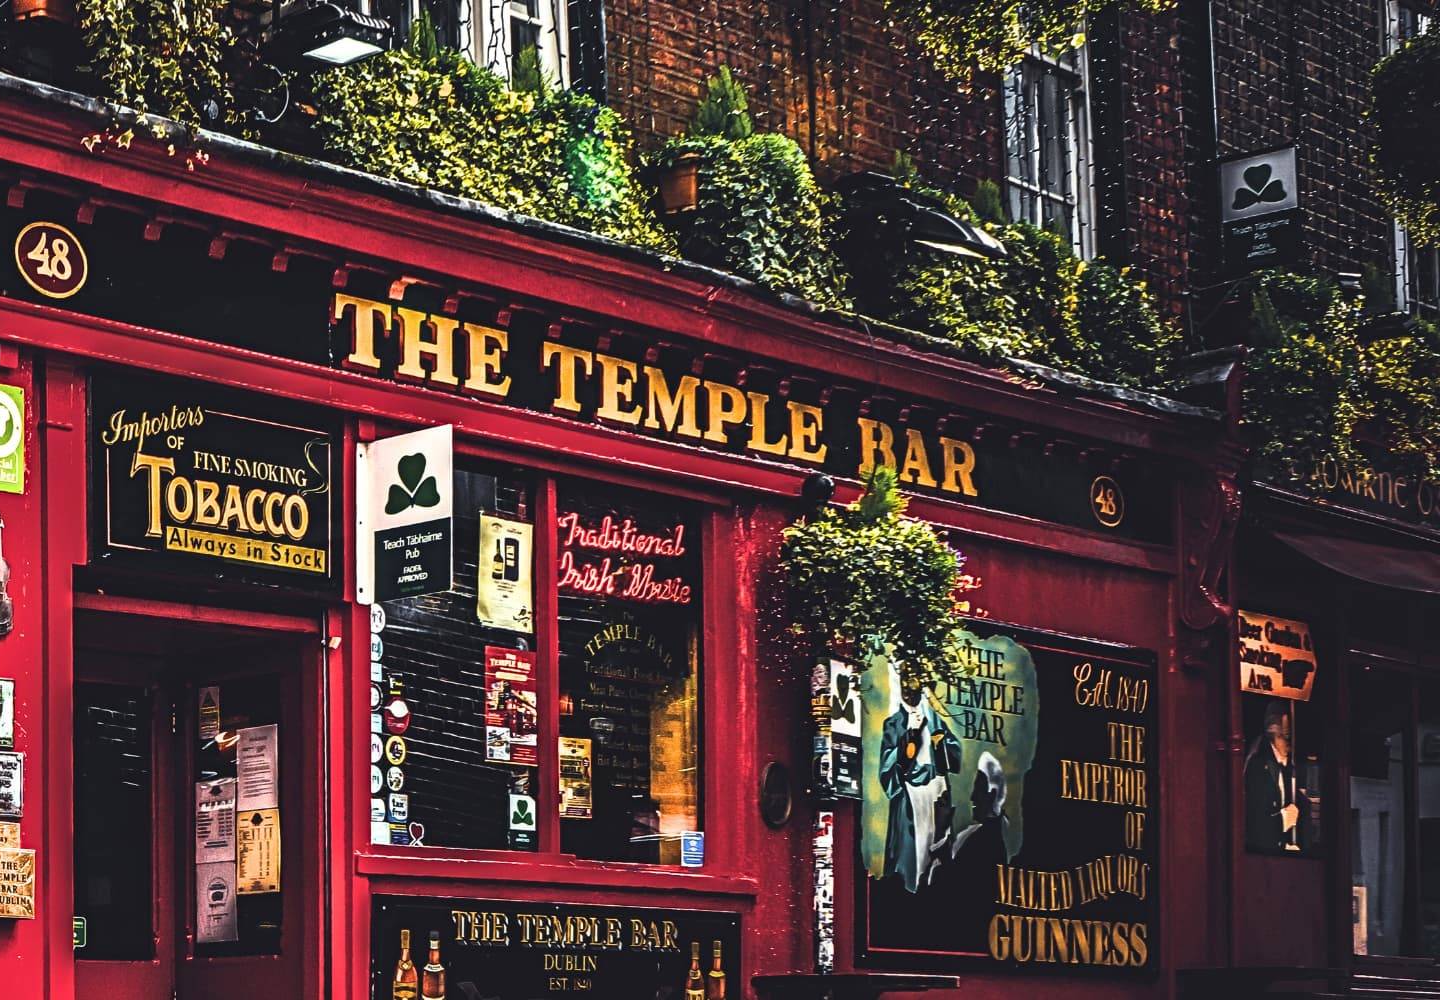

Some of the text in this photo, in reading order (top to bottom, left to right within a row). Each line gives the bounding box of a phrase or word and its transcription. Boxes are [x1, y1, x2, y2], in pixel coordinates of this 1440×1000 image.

[27, 232, 72, 280] 48
[335, 293, 978, 497] THE TEMPLE BAR
[102, 405, 204, 451] Importers
[167, 436, 184, 450] OF
[193, 450, 308, 487] FINE SMOKING
[130, 451, 309, 541] TOBACCO
[1095, 484, 1117, 515] 48
[169, 527, 323, 569] Always in Stock
[383, 537, 405, 550] Teach
[557, 512, 685, 556] Traditional
[405, 548, 420, 560] Pub
[557, 551, 614, 595] Irish
[623, 563, 691, 604] Music
[584, 624, 642, 657] TEMPLE
[963, 646, 1006, 680] THE
[944, 677, 1024, 716] TEMPLE
[963, 710, 1007, 746] BAR
[1107, 721, 1145, 764] THE
[1060, 759, 1147, 808] EMPEROR
[1125, 811, 1146, 850] OF
[1, 861, 18, 871] THE
[995, 854, 1148, 911] MALTED LIQUORS
[1, 884, 18, 894] BAR
[451, 910, 680, 952] THE TEMPLE BAR
[989, 914, 1148, 967] GUINNESS
[544, 954, 598, 972] DUBLIN
[549, 978, 569, 991] EST.
